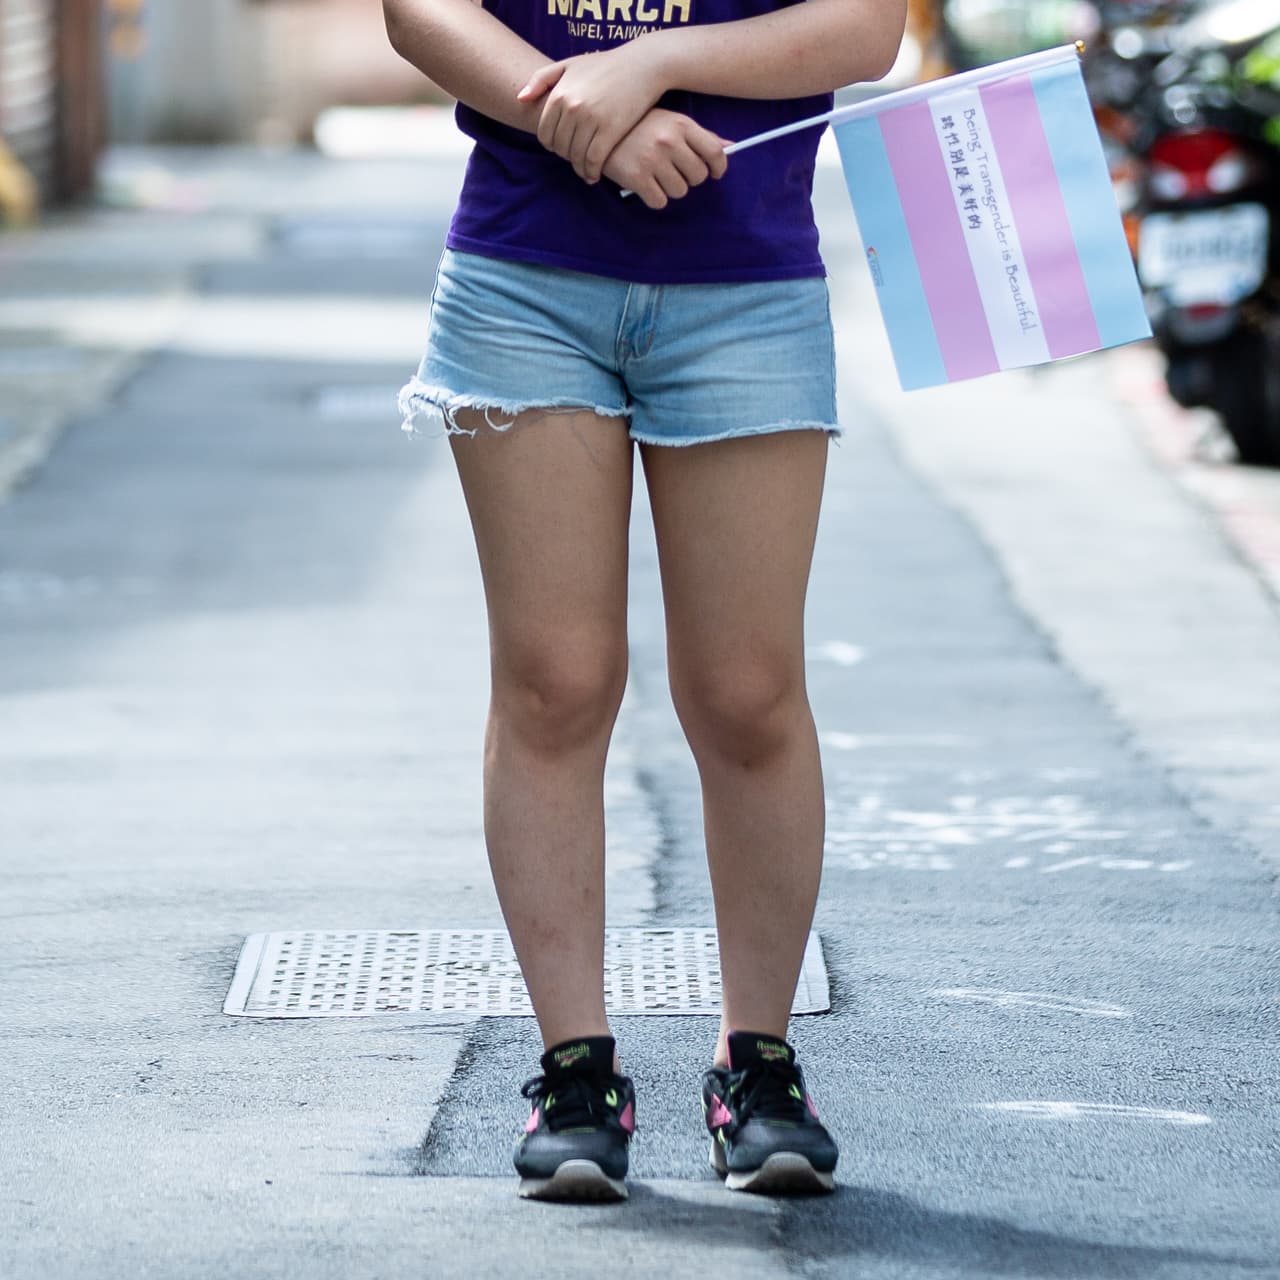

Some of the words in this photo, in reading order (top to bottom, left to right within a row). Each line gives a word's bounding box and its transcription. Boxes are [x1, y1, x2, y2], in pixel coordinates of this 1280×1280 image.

[566, 20, 604, 40] TAIPEI,
[963, 108, 982, 152] Being
[976, 151, 1011, 247] Transgender
[1002, 248, 1015, 261] is
